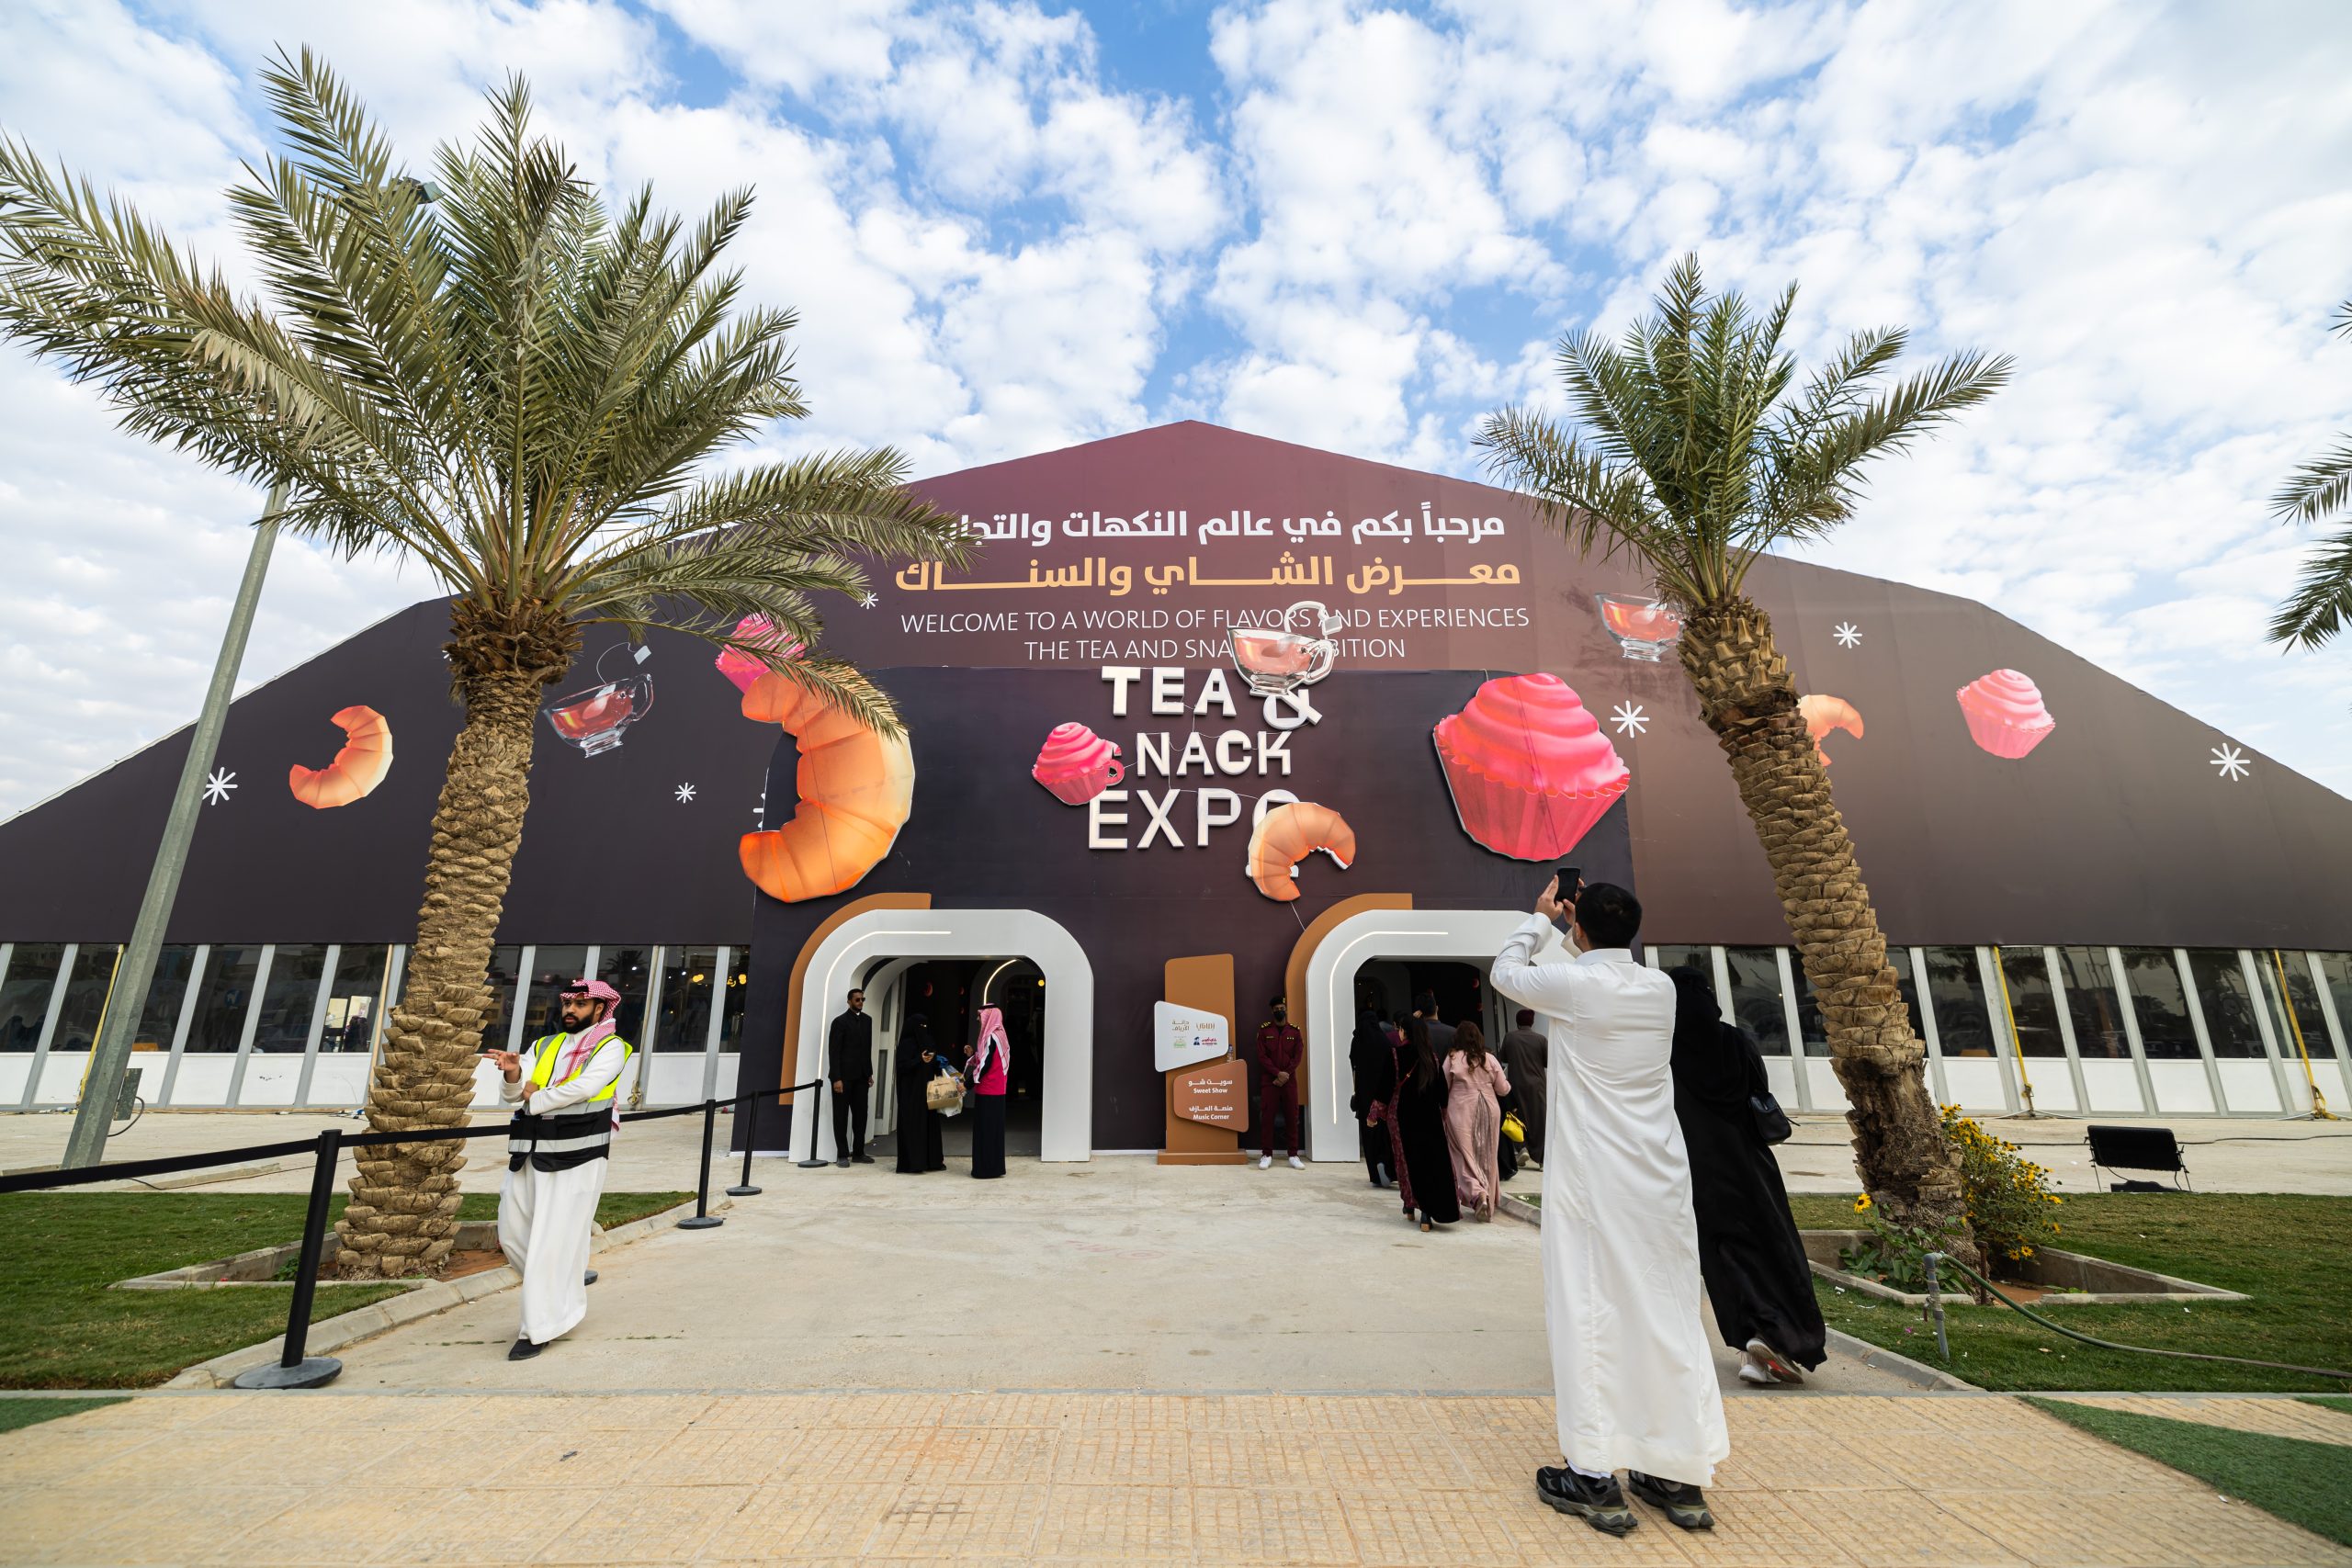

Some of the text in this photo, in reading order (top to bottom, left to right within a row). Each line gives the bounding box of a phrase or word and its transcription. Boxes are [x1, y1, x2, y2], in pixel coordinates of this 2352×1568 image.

[1062, 510, 1187, 537] النكهات
[1198, 510, 1273, 545] عالم
[1283, 511, 1341, 544] في
[1351, 510, 1412, 545] بكم
[1421, 502, 1505, 544] مرحباً
[900, 612, 1019, 633] WELCOME
[1024, 611, 1056, 631] TO
[1061, 611, 1078, 630] A
[1082, 610, 1169, 630] WORLD
[1175, 610, 1205, 629] OF
[1379, 607, 1530, 628] EXPERIENCES
[1023, 640, 1069, 660] THE
[1075, 640, 1118, 660] TEA
[1124, 639, 1178, 660] AND
[1184, 639, 1233, 659] SNA
[1102, 666, 1238, 717] TEA
